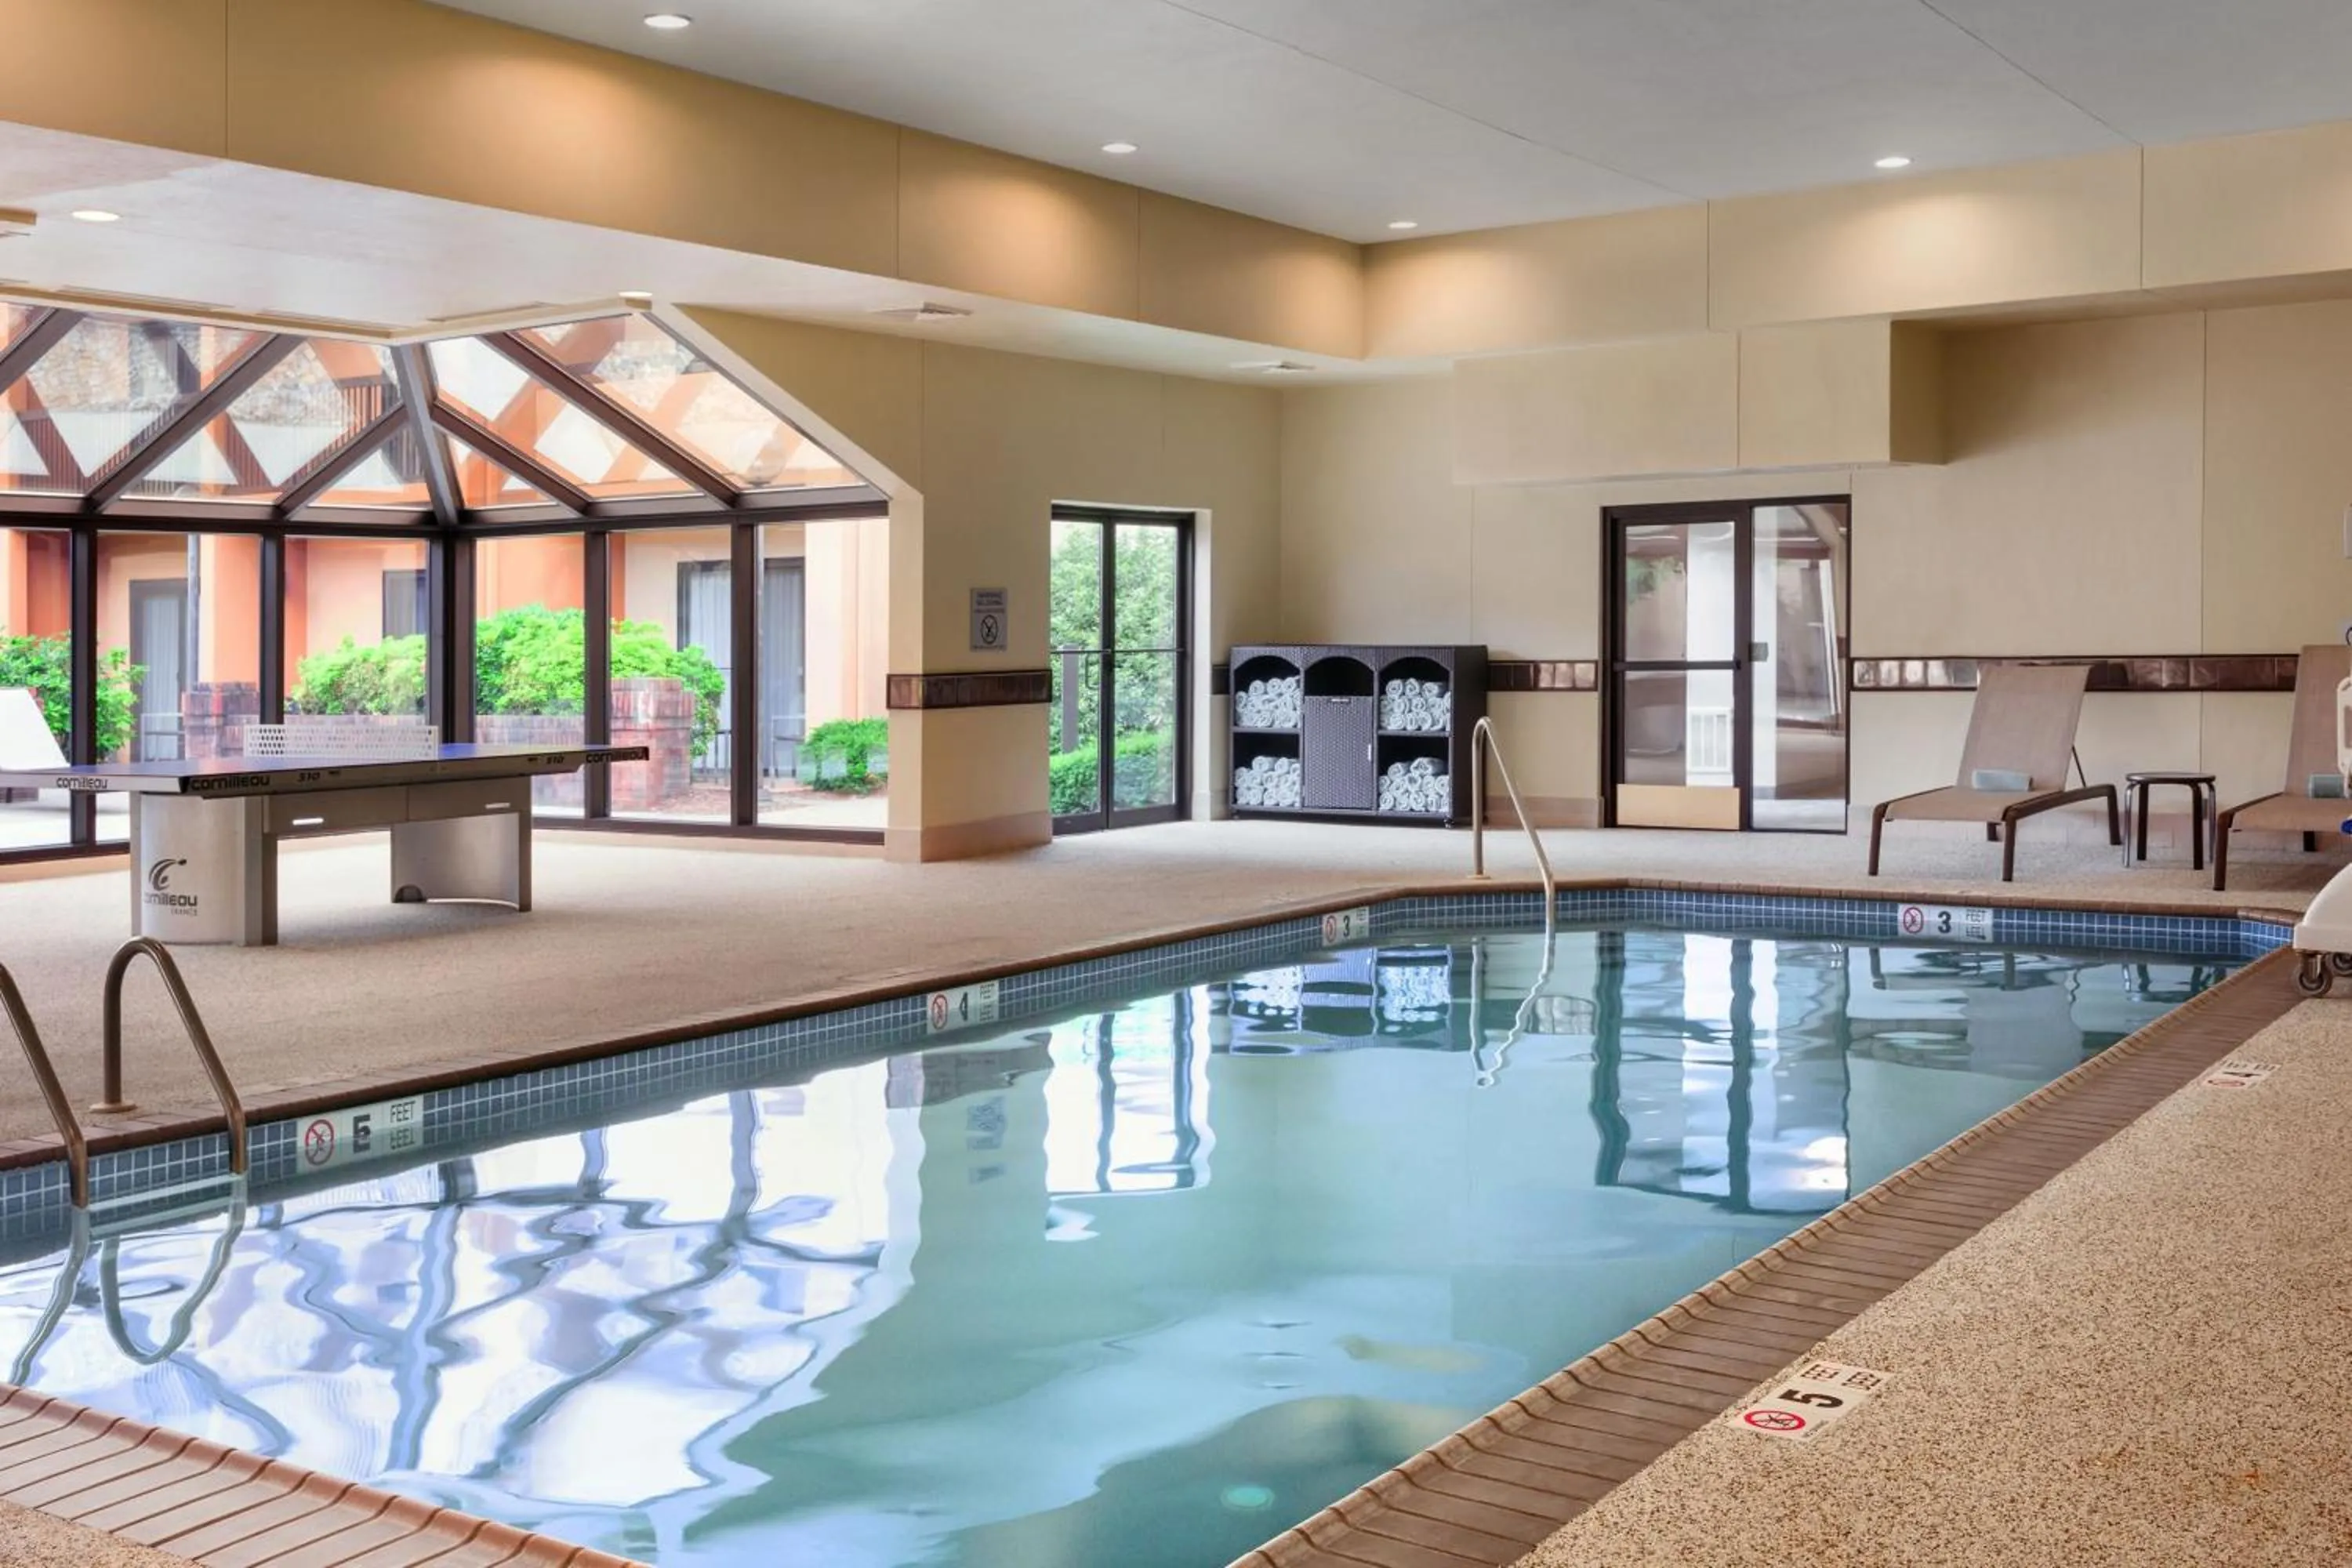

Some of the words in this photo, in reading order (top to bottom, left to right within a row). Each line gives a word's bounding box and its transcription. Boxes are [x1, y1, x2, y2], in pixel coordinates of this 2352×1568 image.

[191, 774, 270, 791] cornilleau
[1343, 915, 1350, 937] 3
[1937, 910, 1951, 934] 3
[390, 1101, 416, 1123] FEET
[1801, 1364, 1840, 1381] FEET
[1778, 1388, 1844, 1409] 5
